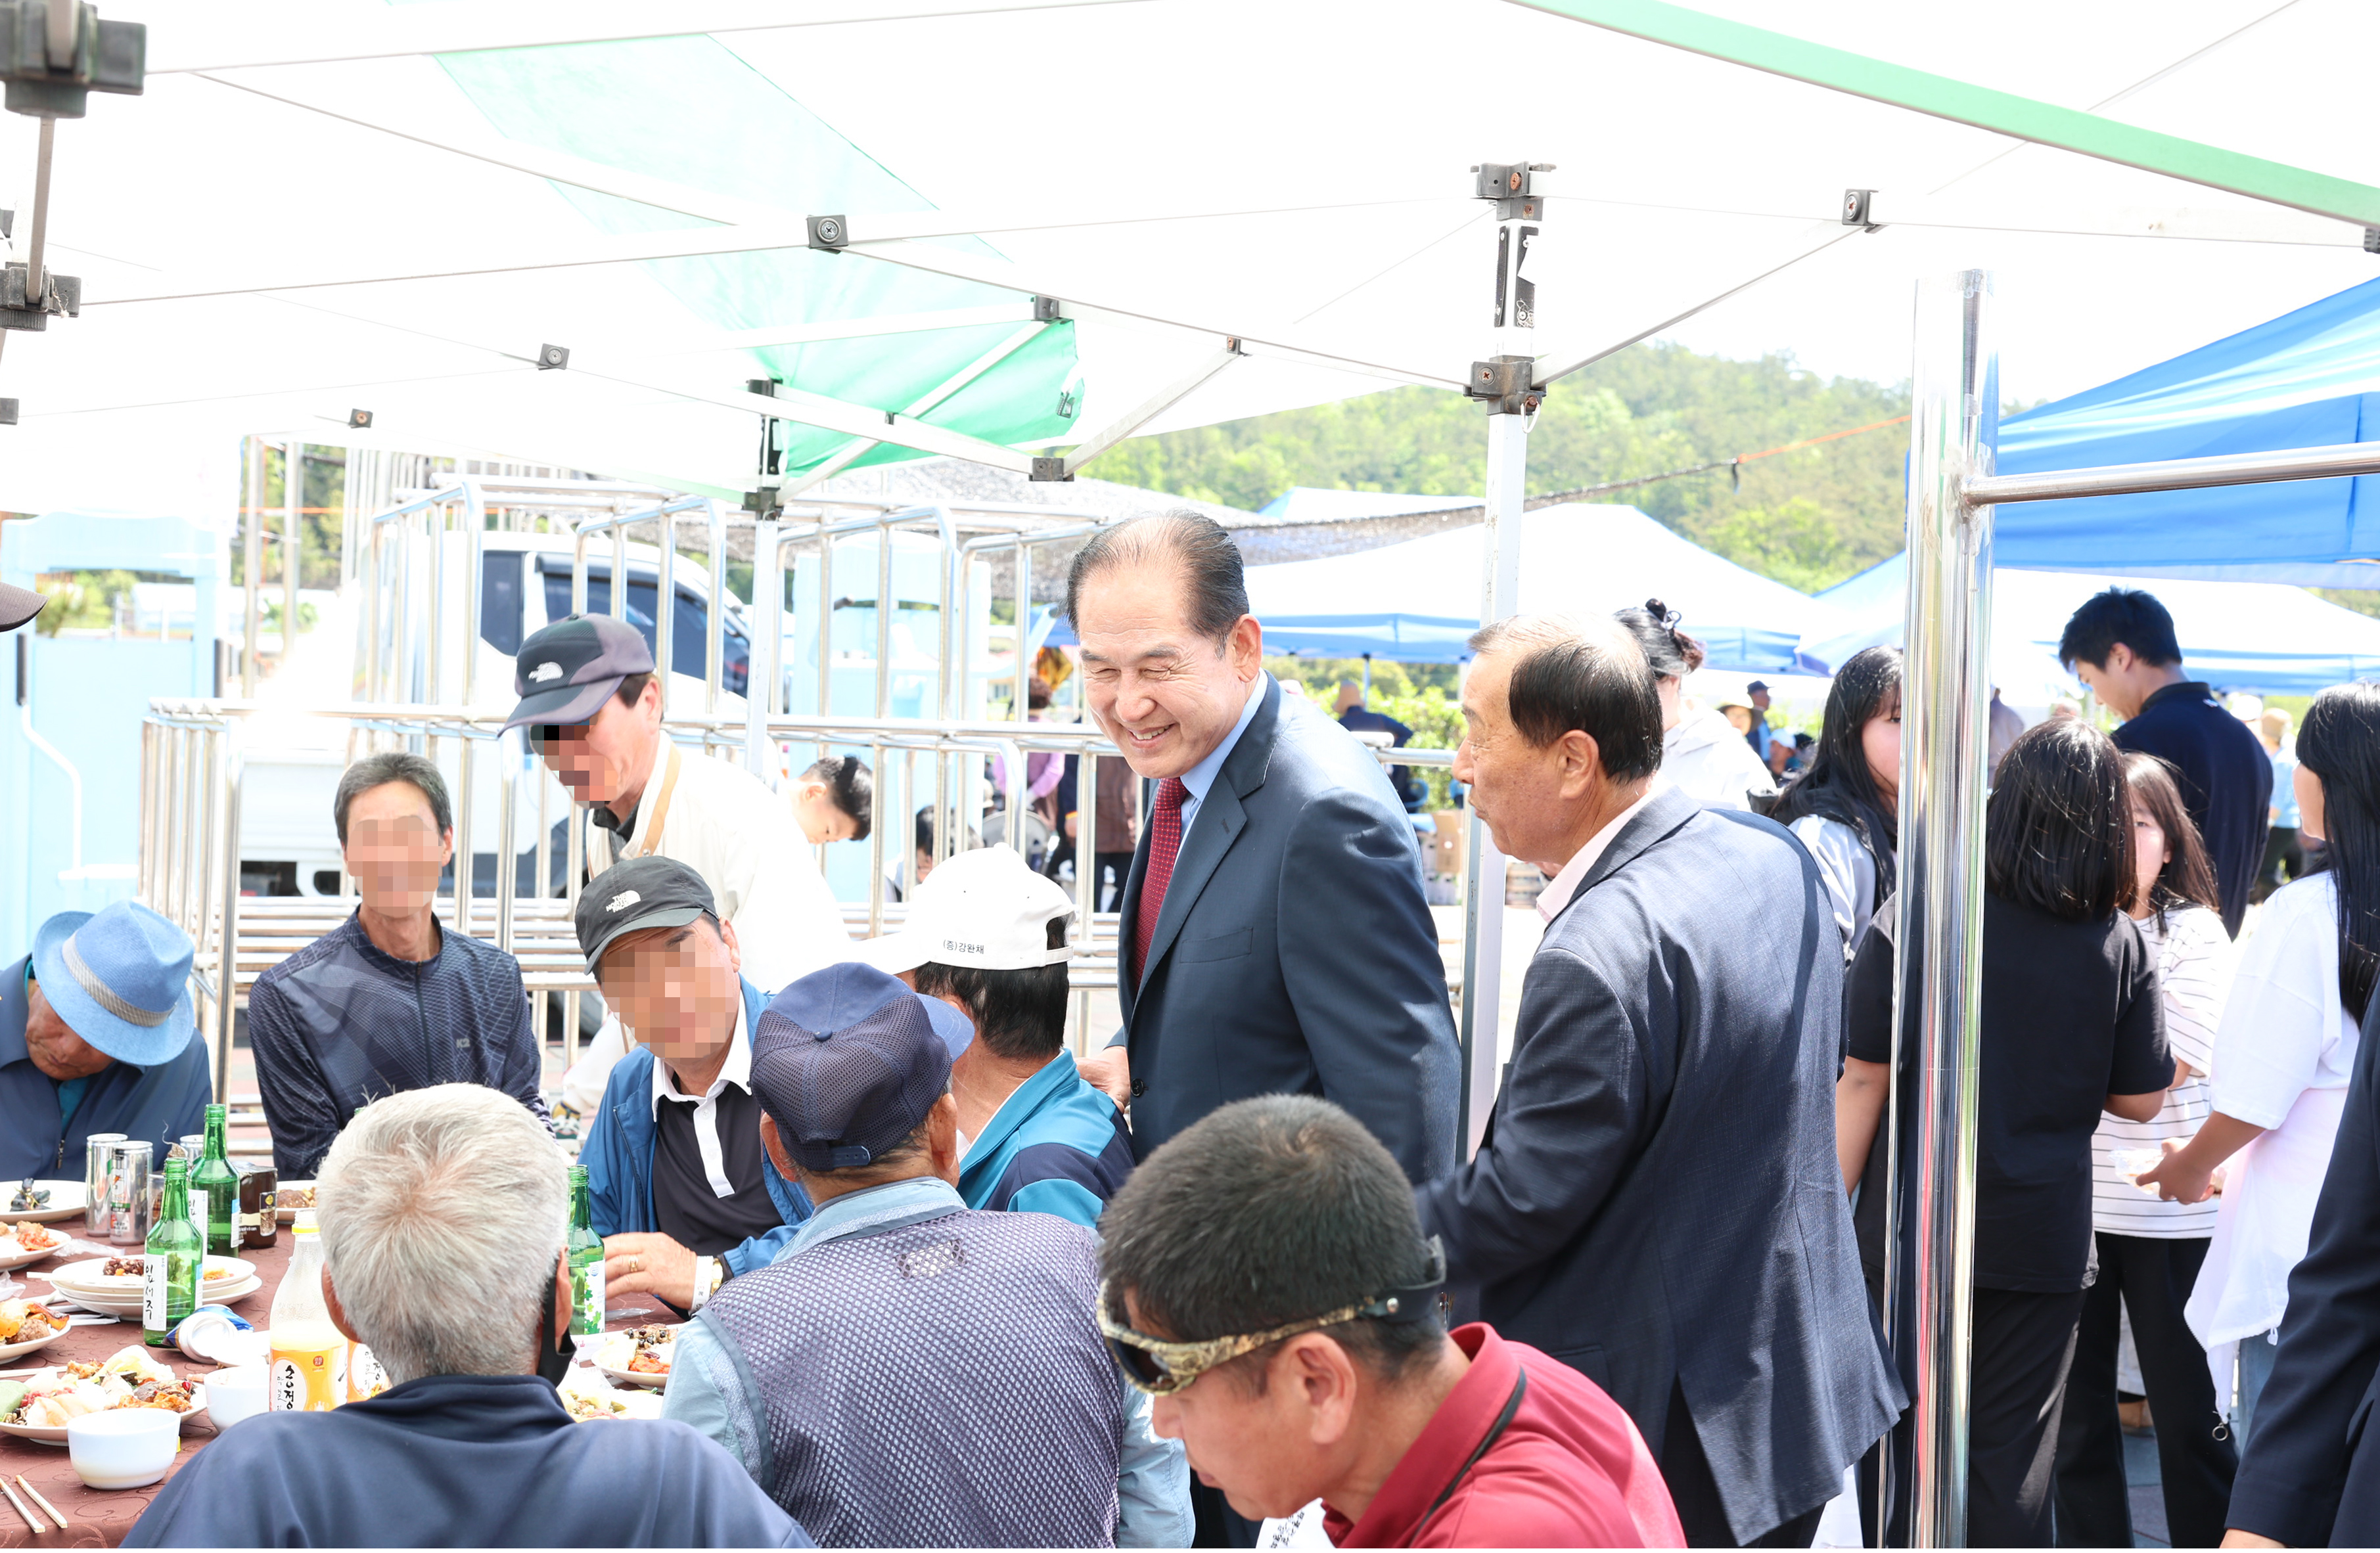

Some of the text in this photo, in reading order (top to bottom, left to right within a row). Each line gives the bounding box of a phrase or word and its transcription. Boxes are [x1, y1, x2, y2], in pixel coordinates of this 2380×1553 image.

[606, 895, 626, 912] NORTH
[456, 1038, 470, 1048] K2
[283, 1364, 295, 1410] 송정
